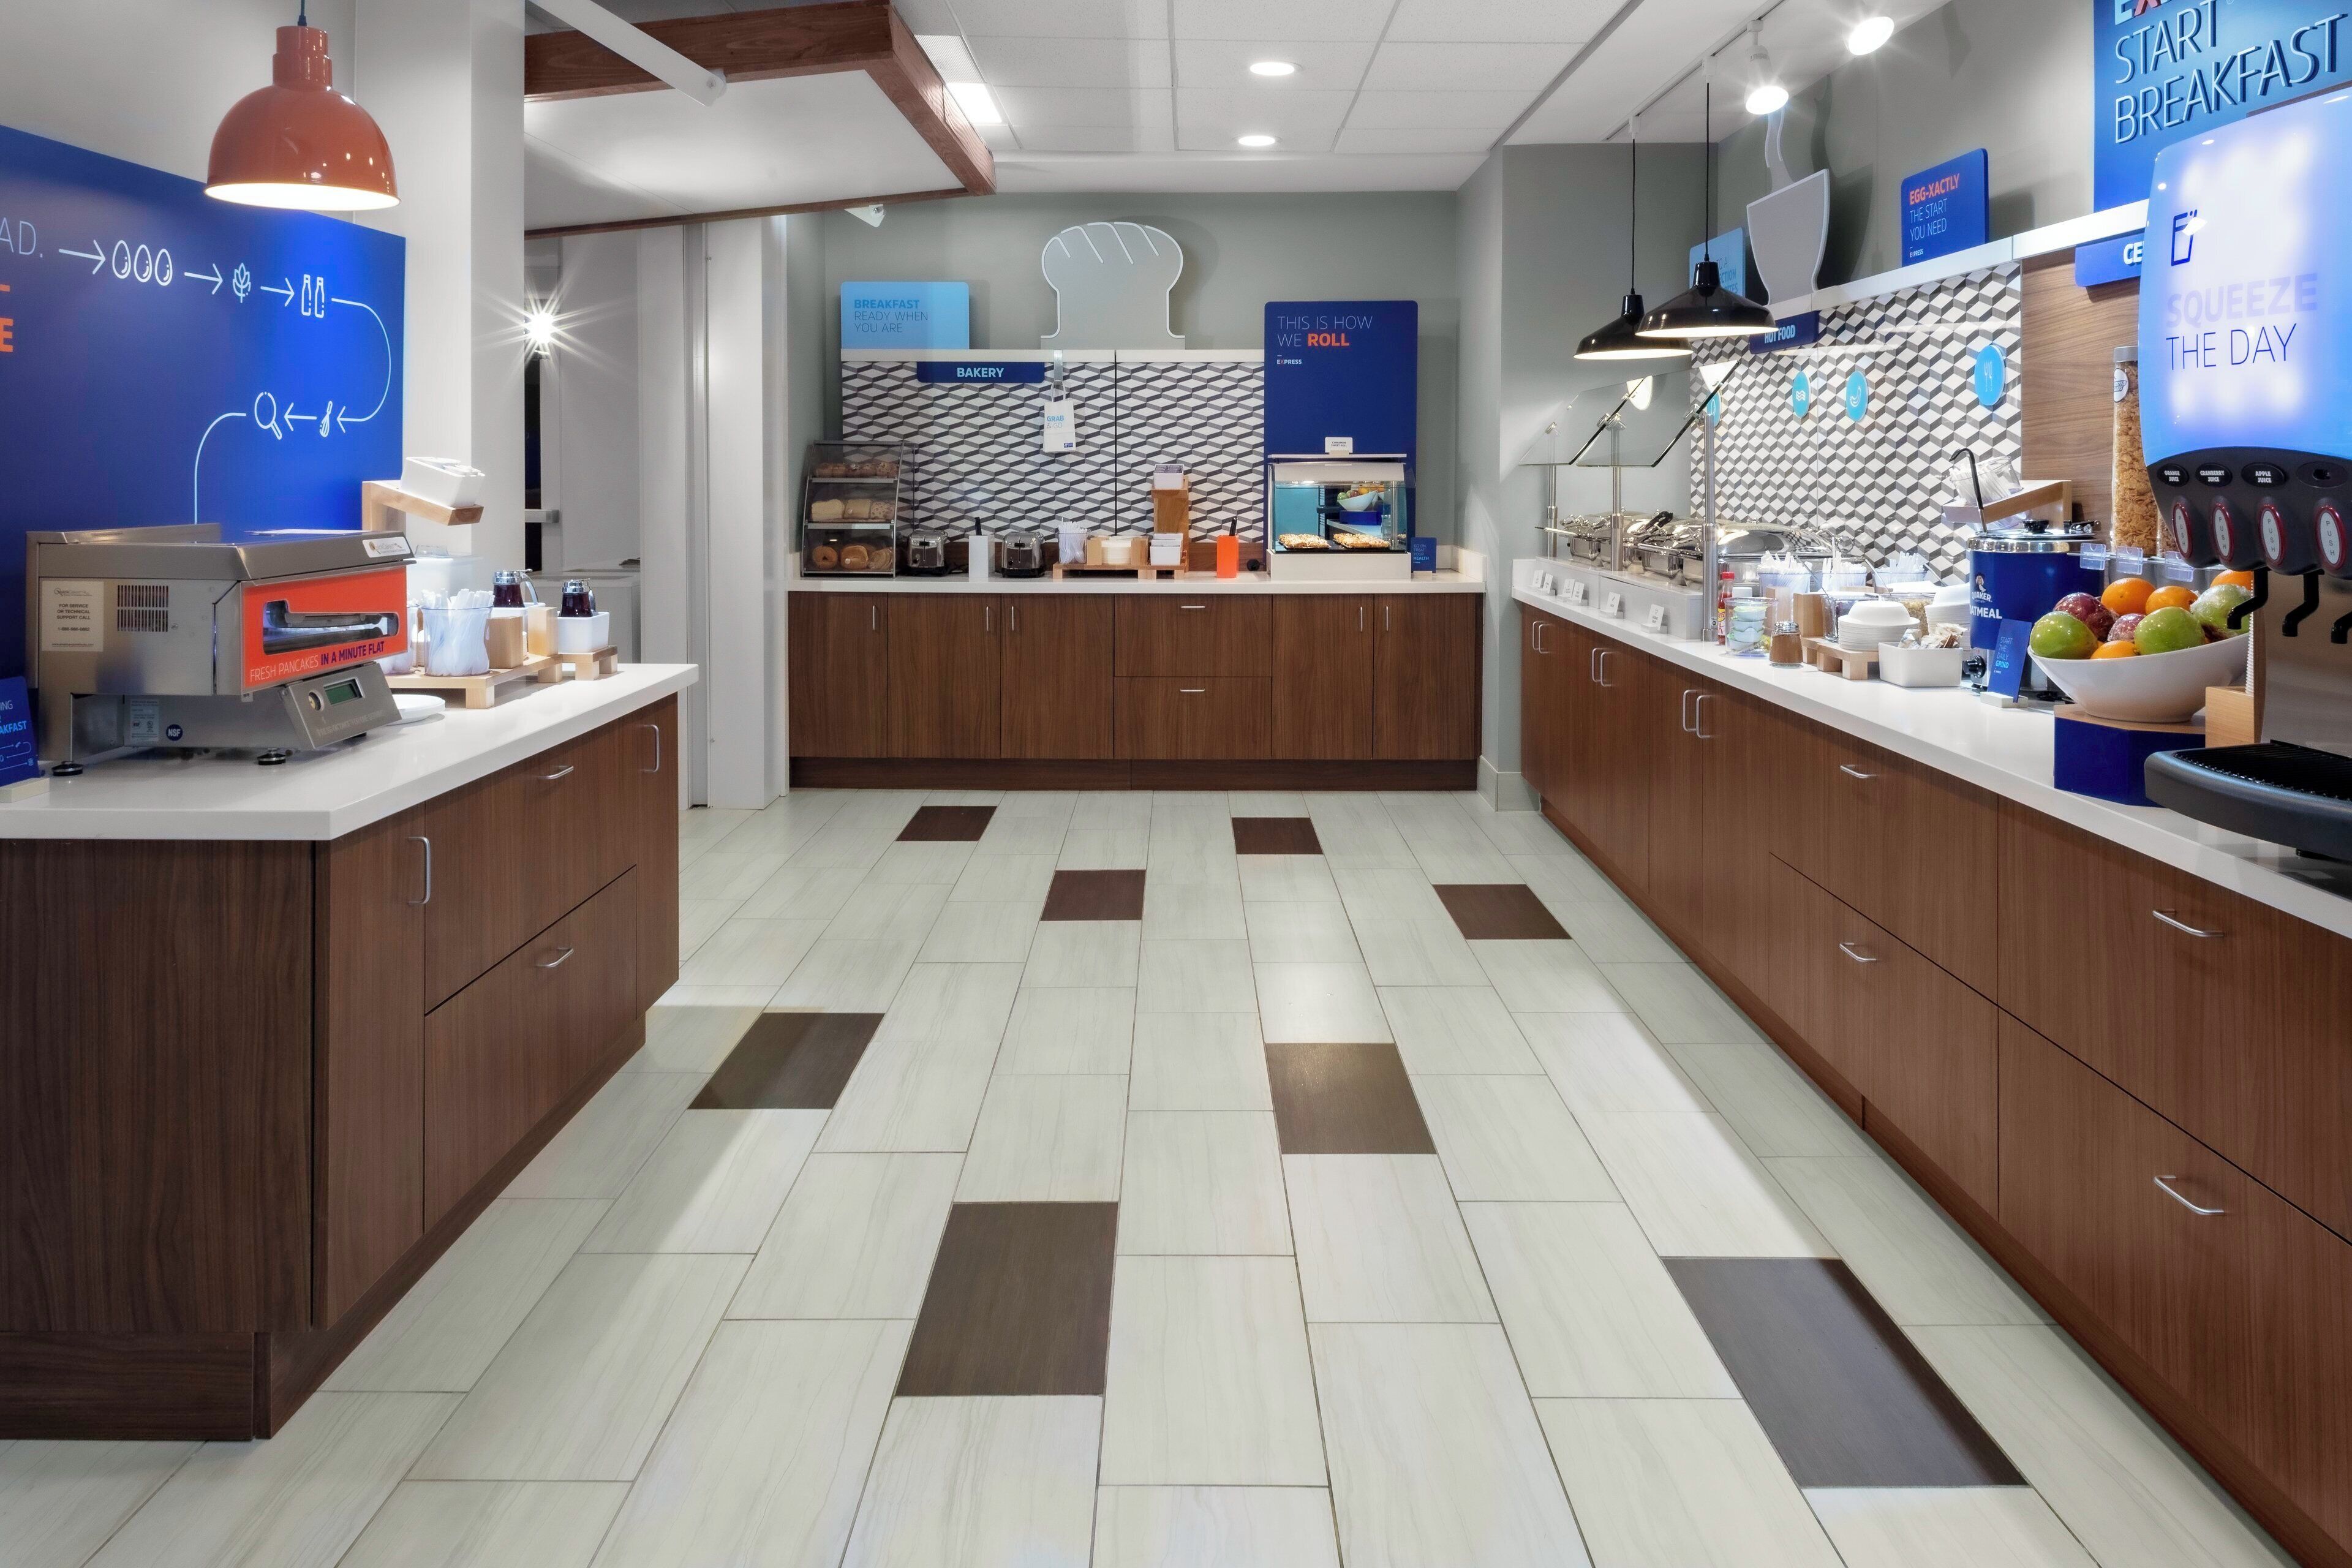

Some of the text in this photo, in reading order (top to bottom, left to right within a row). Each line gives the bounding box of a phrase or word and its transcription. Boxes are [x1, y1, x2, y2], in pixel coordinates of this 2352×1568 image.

[2116, 0, 2217, 83] START
[2116, 13, 2346, 144] BREAKFAST
[1910, 173, 1959, 205] EGG-XACTLY
[1910, 198, 1947, 224] THE START
[1910, 218, 1947, 241] YOU NEED
[854, 300, 920, 309] BREAKFAST
[2166, 273, 2318, 328] SQUEEZE
[854, 311, 928, 320] READY WHEN
[1277, 315, 1373, 330] THIS IS HOW
[854, 323, 903, 333] YOU ARE
[1778, 325, 1796, 341] FOOD
[1277, 333, 1350, 347] WE ROLL
[2166, 323, 2297, 371] THE DAY
[957, 368, 1005, 377] BAKERY
[2326, 521, 2335, 556] PUSH
[1972, 592, 1991, 602] QUAKER
[250, 641, 385, 682] FRESH PANCAKES IN A MINUTE FLAT
[1997, 652, 2009, 660] DAILY
[168, 728, 181, 737] NSF
